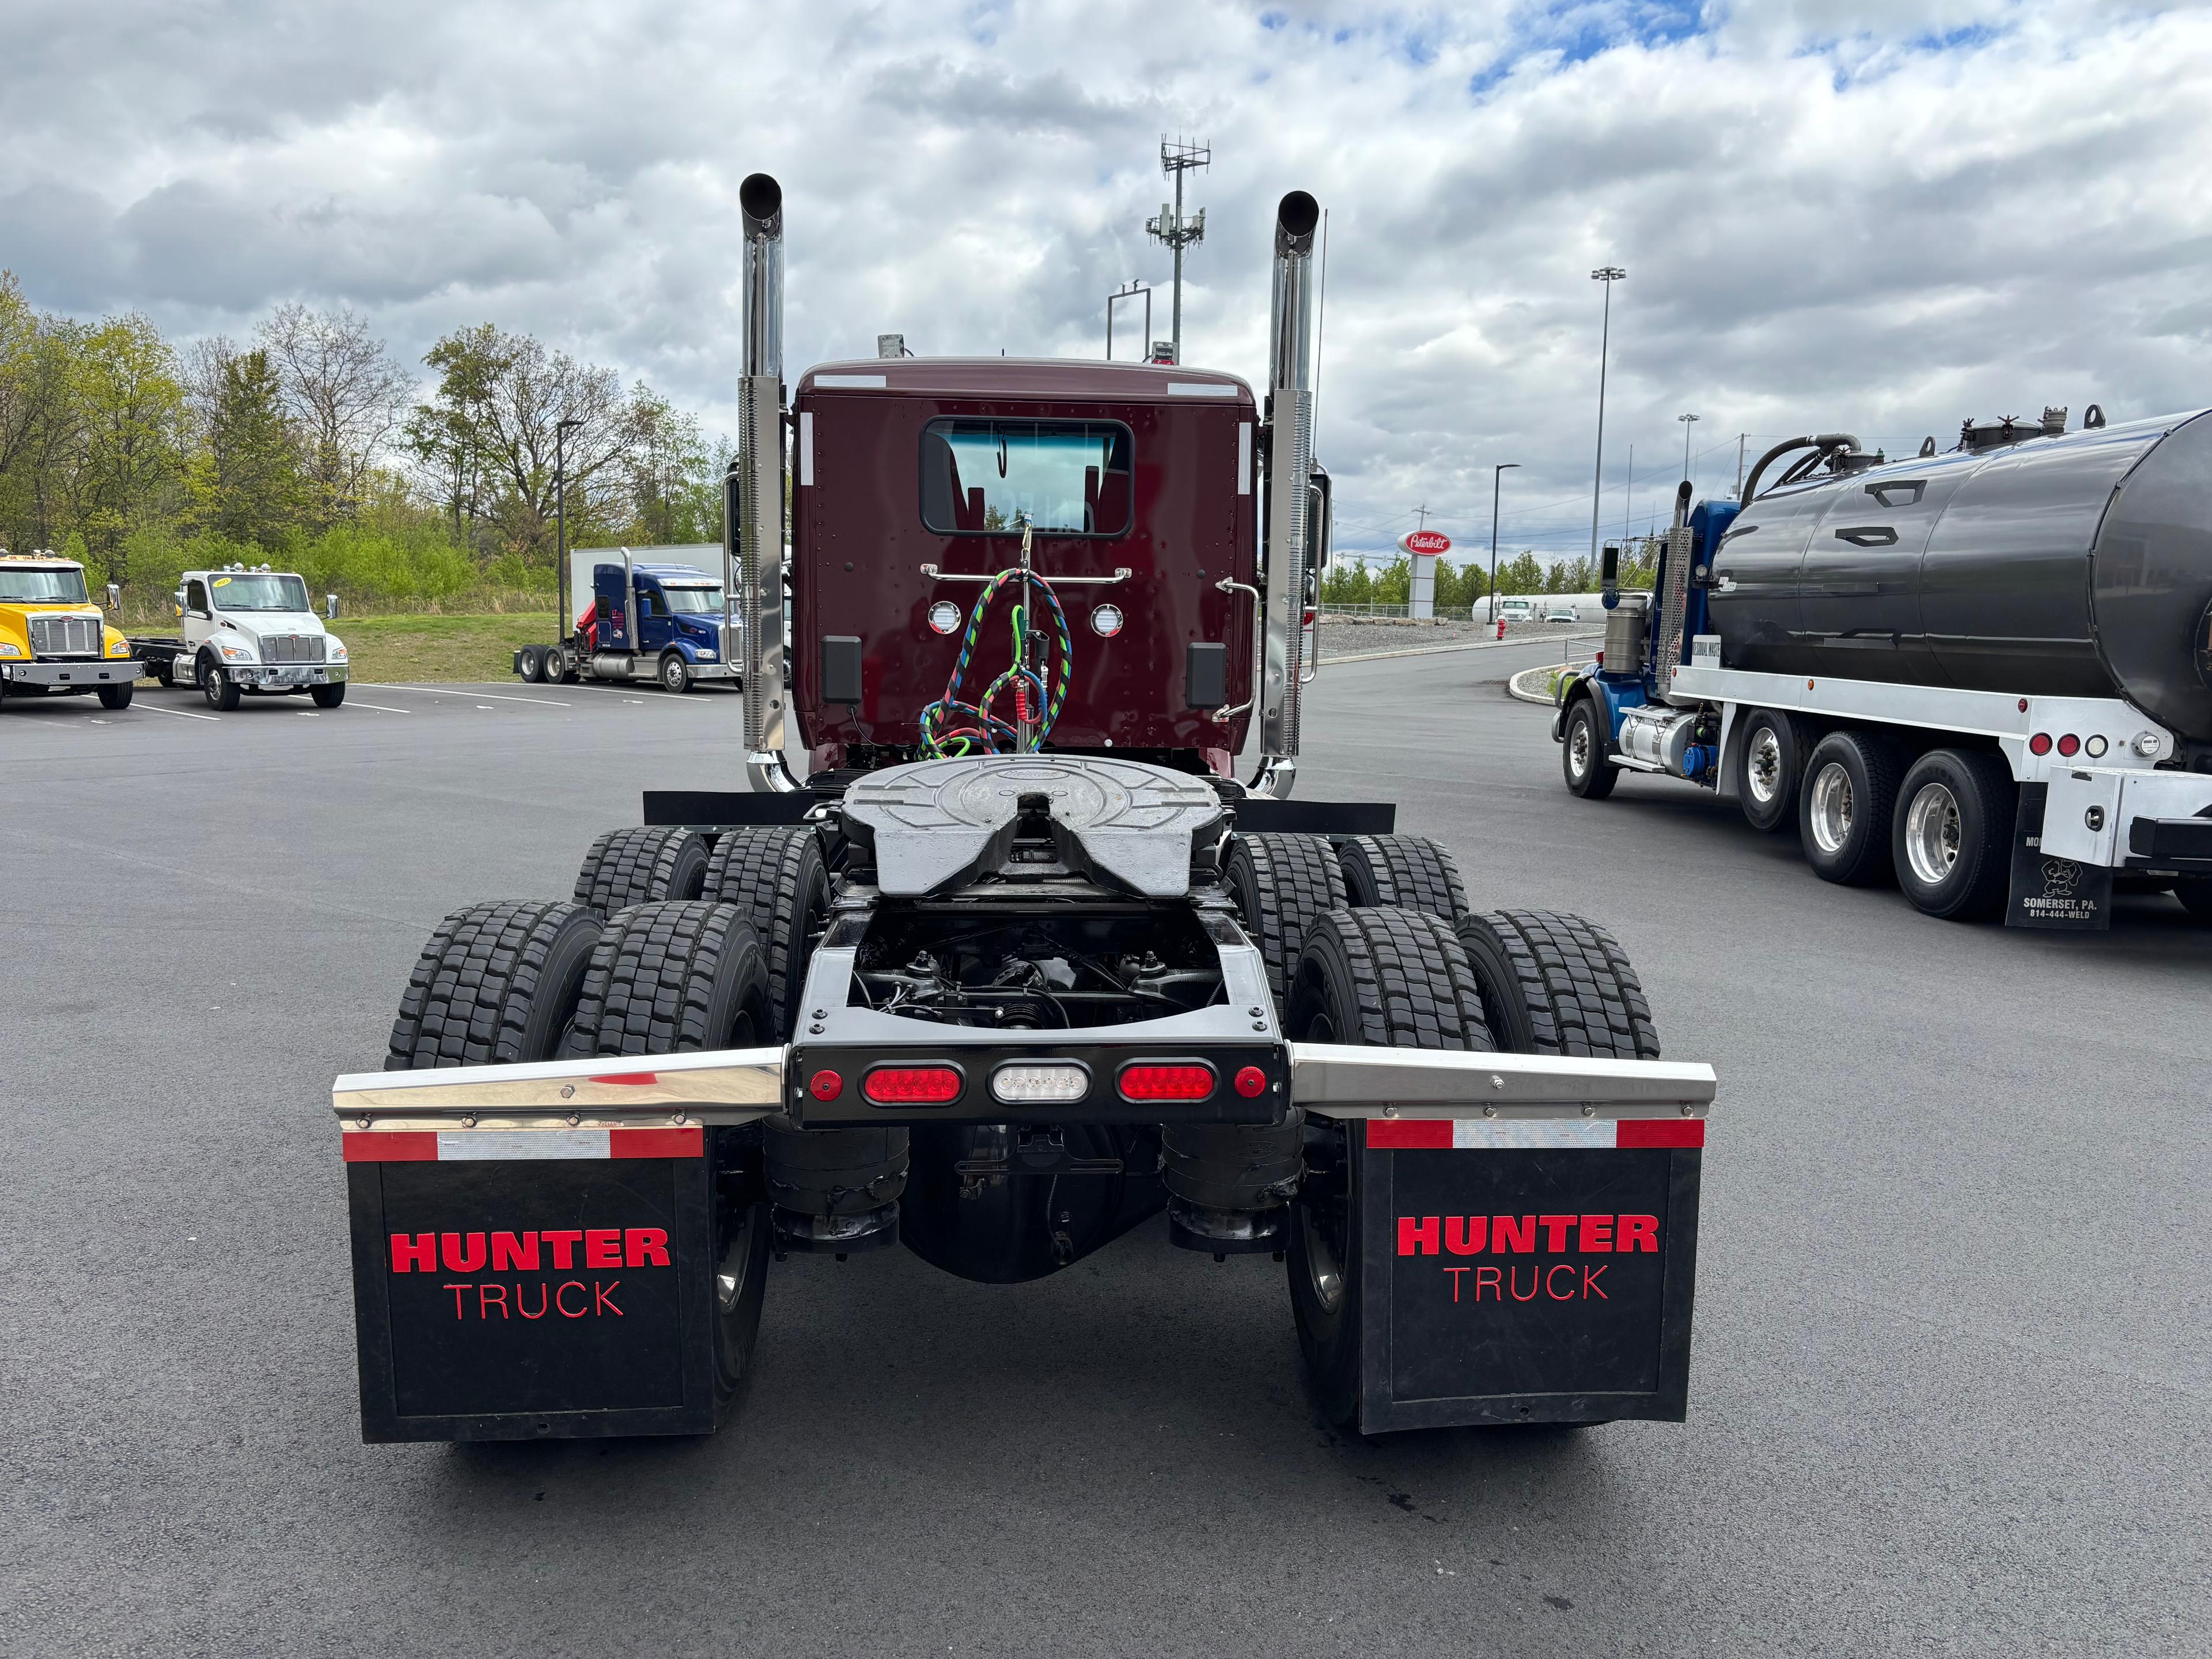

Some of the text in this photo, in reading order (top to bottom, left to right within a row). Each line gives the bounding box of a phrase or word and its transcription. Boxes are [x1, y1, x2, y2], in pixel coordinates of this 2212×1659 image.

[1410, 534, 1448, 550] Peterbilt
[2023, 897, 2097, 911] SOMERSET, PA.
[2029, 909, 2090, 919] 814-444-WELD
[390, 1228, 671, 1272] HUNTER
[1397, 1214, 1659, 1255] HUNTER
[443, 1281, 624, 1320] TRUCK
[1443, 1264, 1609, 1302] TRUCK
